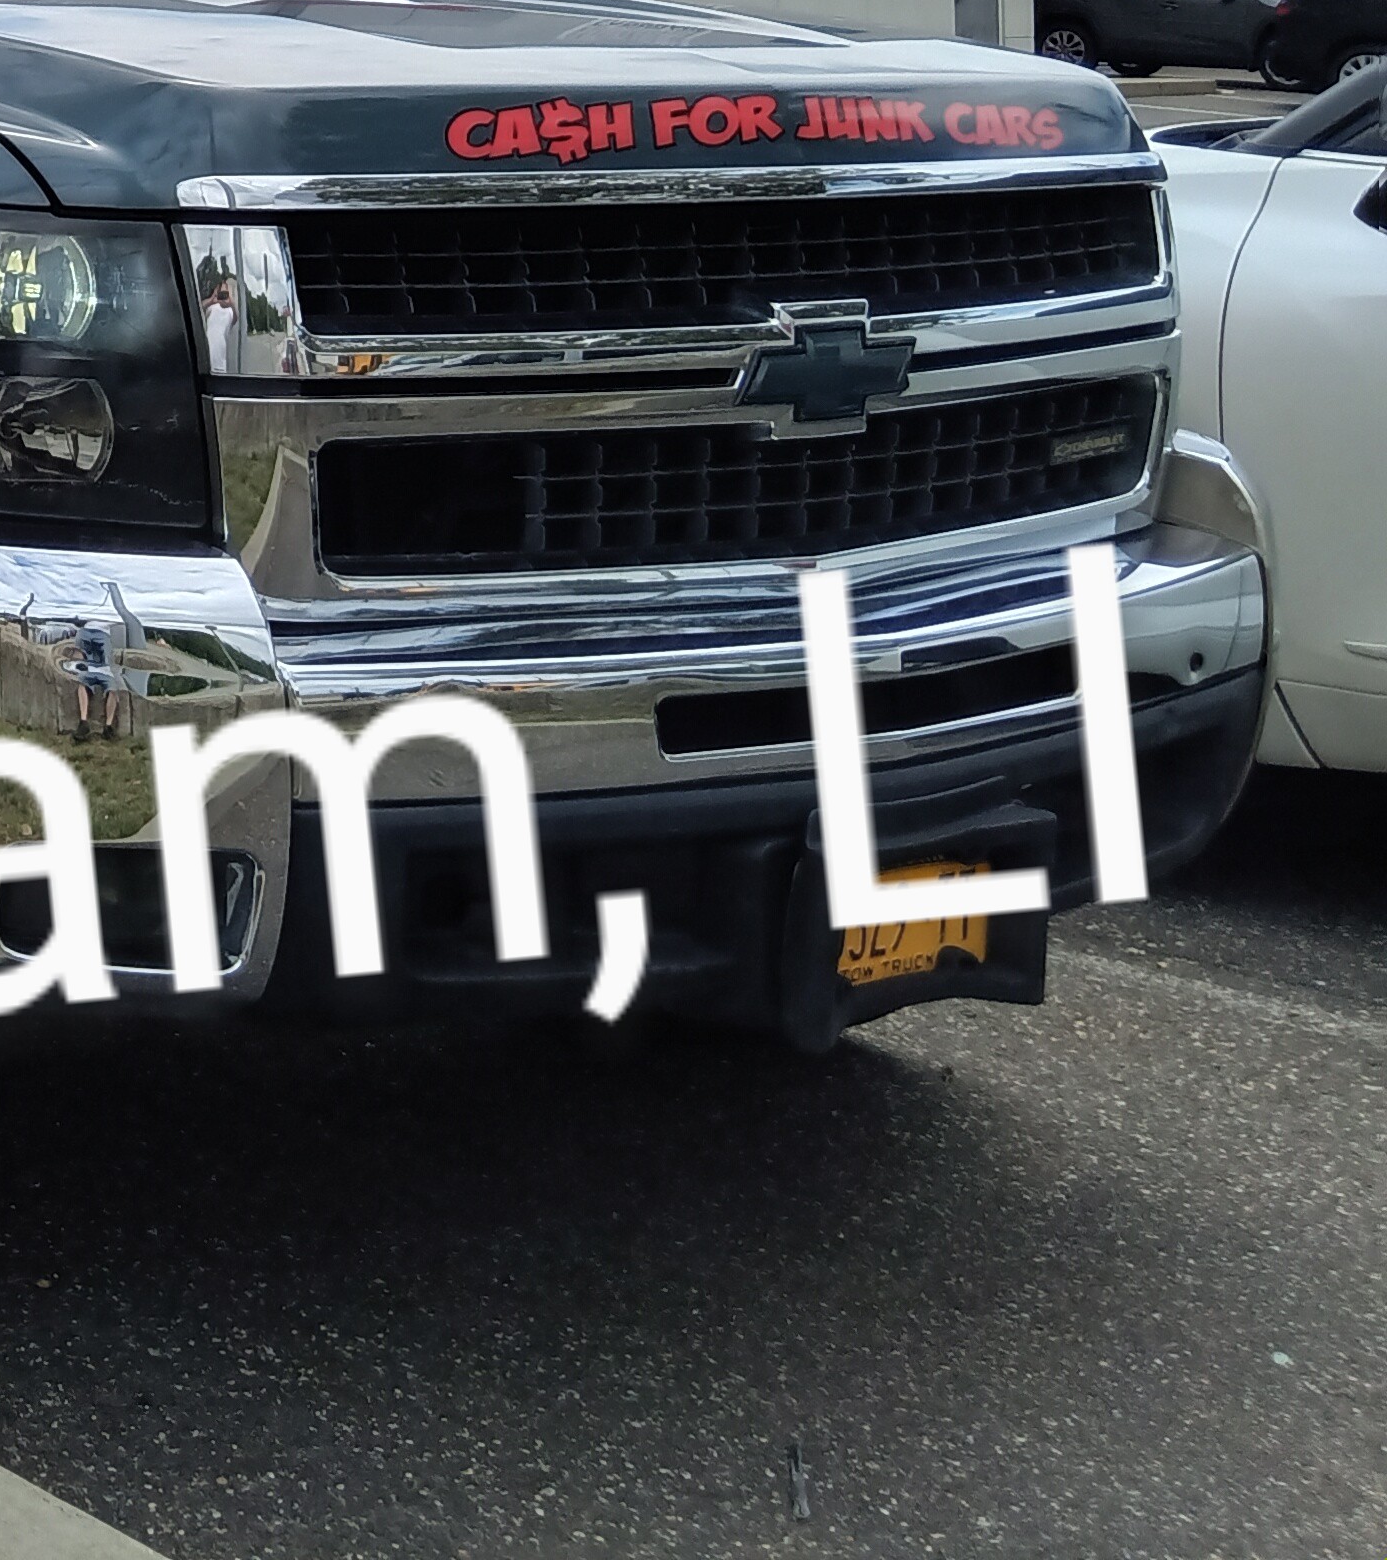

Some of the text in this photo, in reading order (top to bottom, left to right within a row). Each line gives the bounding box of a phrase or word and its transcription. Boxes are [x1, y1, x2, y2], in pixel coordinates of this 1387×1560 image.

[444, 93, 1066, 166] CA$H FOR JUNK CARS
[839, 952, 936, 982] TOW TRUCK
